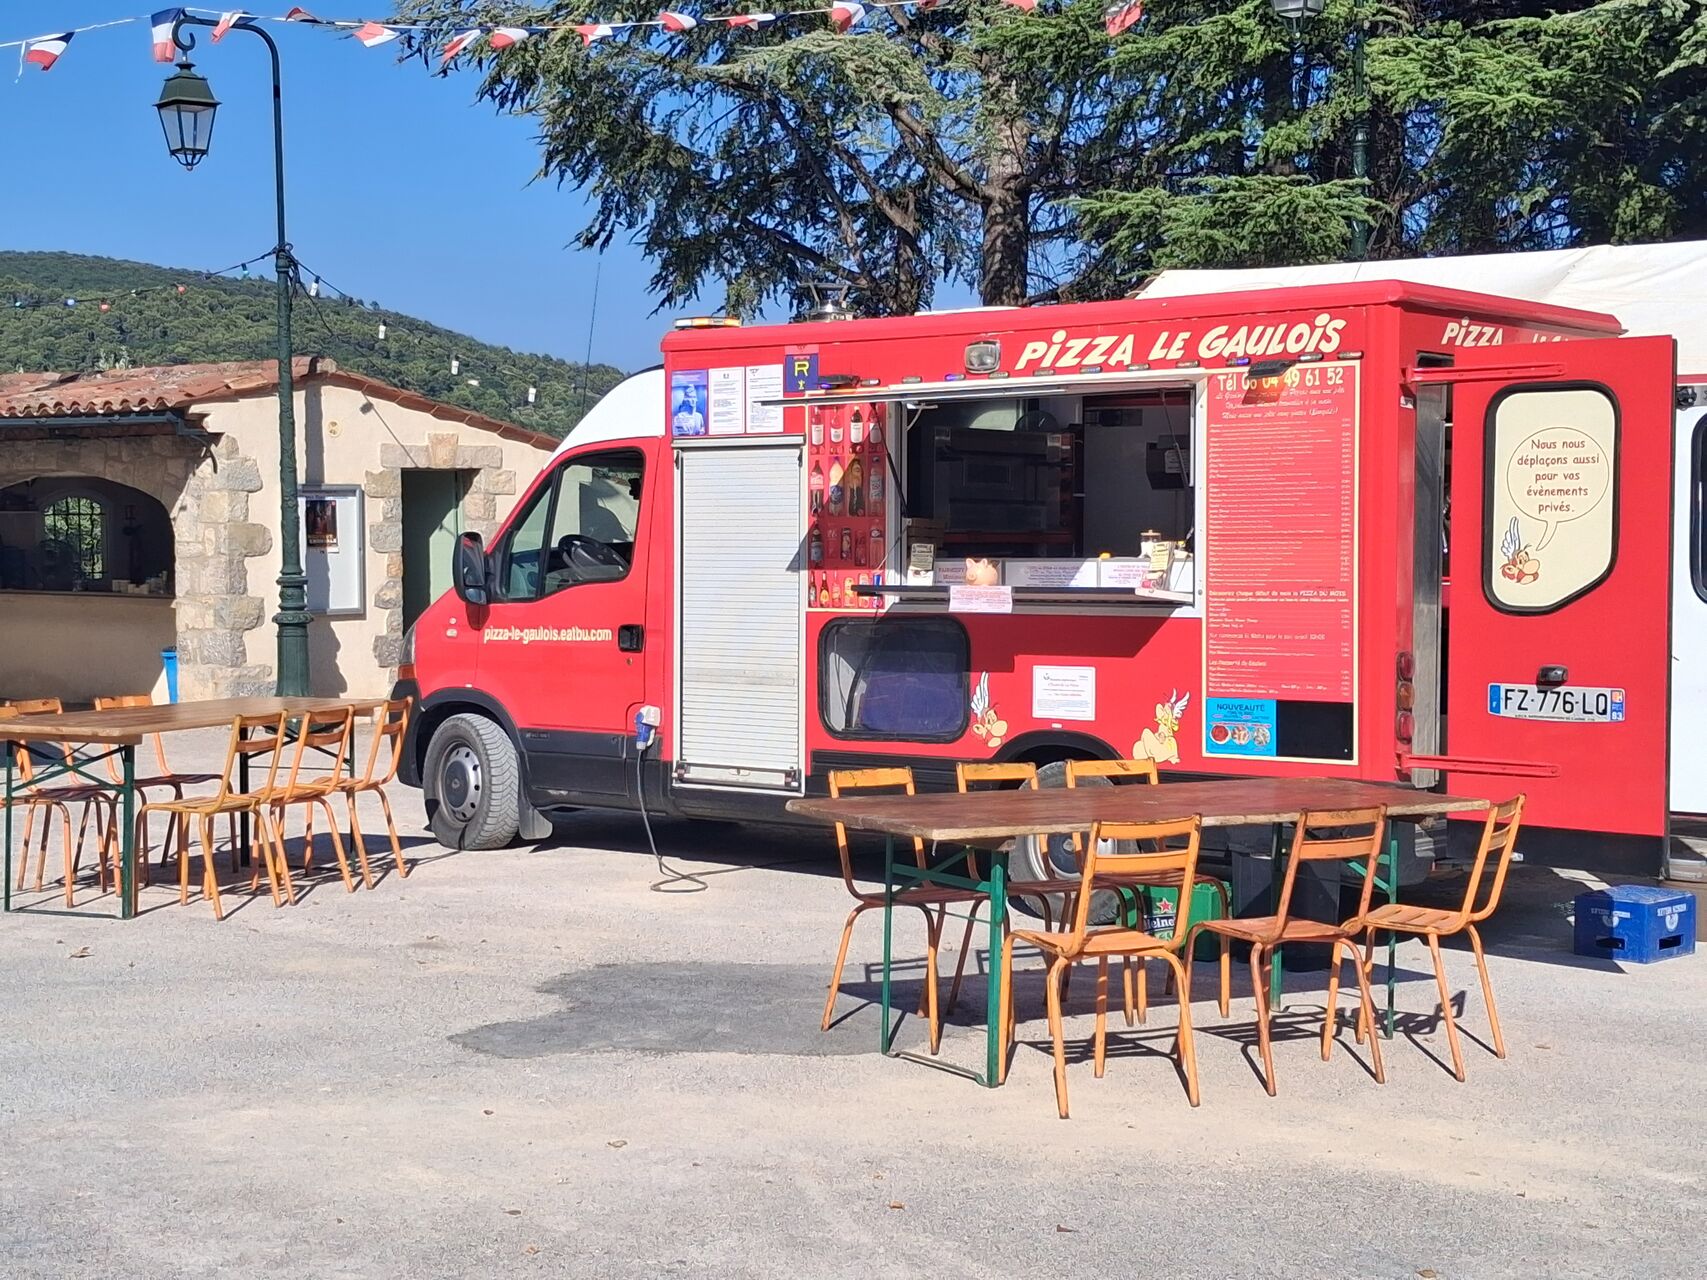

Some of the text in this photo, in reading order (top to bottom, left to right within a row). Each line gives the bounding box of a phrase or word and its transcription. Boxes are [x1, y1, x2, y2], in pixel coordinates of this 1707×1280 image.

[1147, 331, 1192, 361] LE
[1217, 372, 1237, 391] Tél
[1284, 368, 1301, 388] 49
[1305, 369, 1321, 387] 61
[1326, 367, 1344, 386] 52
[1531, 439, 1586, 450] Nous nous
[1517, 453, 1600, 468] déplaçons aussi
[1535, 473, 1580, 484] pour vos
[1526, 485, 1589, 496] évènements
[1538, 500, 1575, 514] privés.
[484, 625, 613, 644] pizza-le-gaulois.eatbu.com
